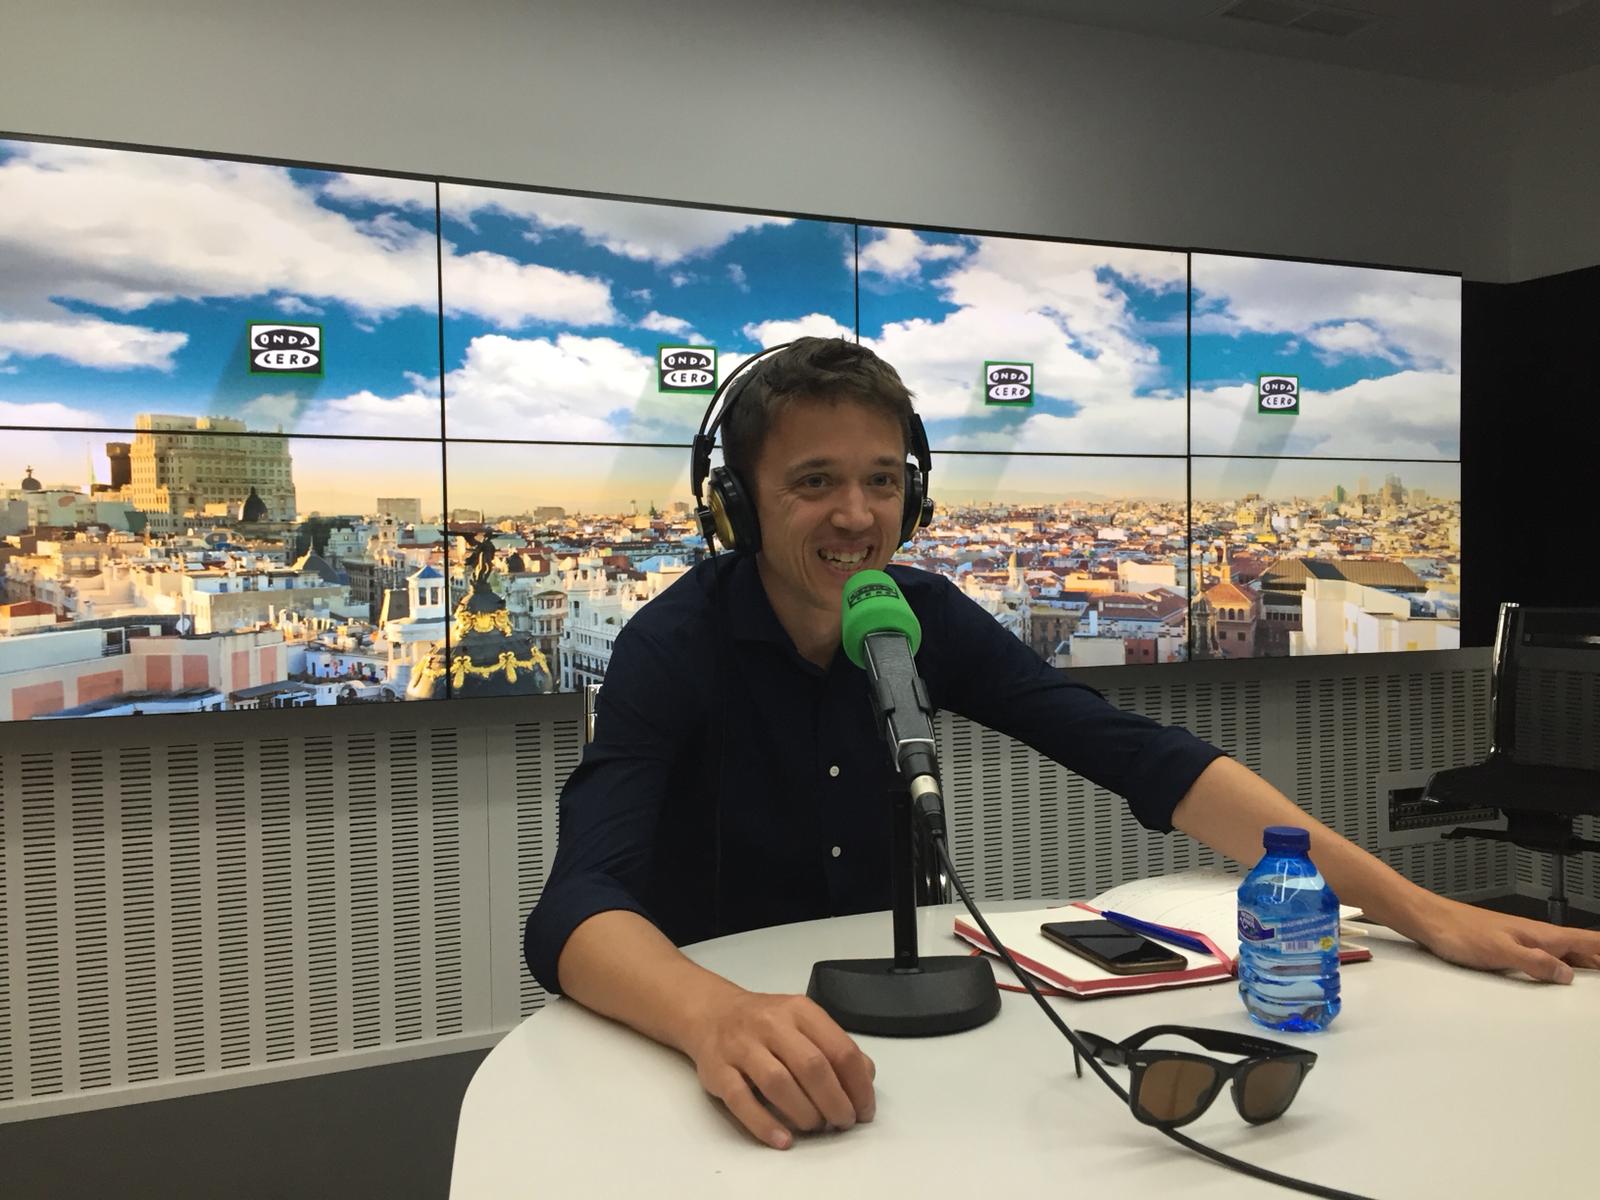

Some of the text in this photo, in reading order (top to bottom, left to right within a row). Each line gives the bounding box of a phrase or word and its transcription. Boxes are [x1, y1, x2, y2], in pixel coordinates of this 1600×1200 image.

[260, 334, 310, 345] ONDA
[264, 353, 310, 364] CERO
[668, 356, 707, 366] ONDA
[671, 373, 707, 383] CERO
[992, 372, 1025, 381] ONDA
[1265, 383, 1292, 391] ONDA
[995, 388, 1025, 397] CERO
[1267, 398, 1292, 406] CERO
